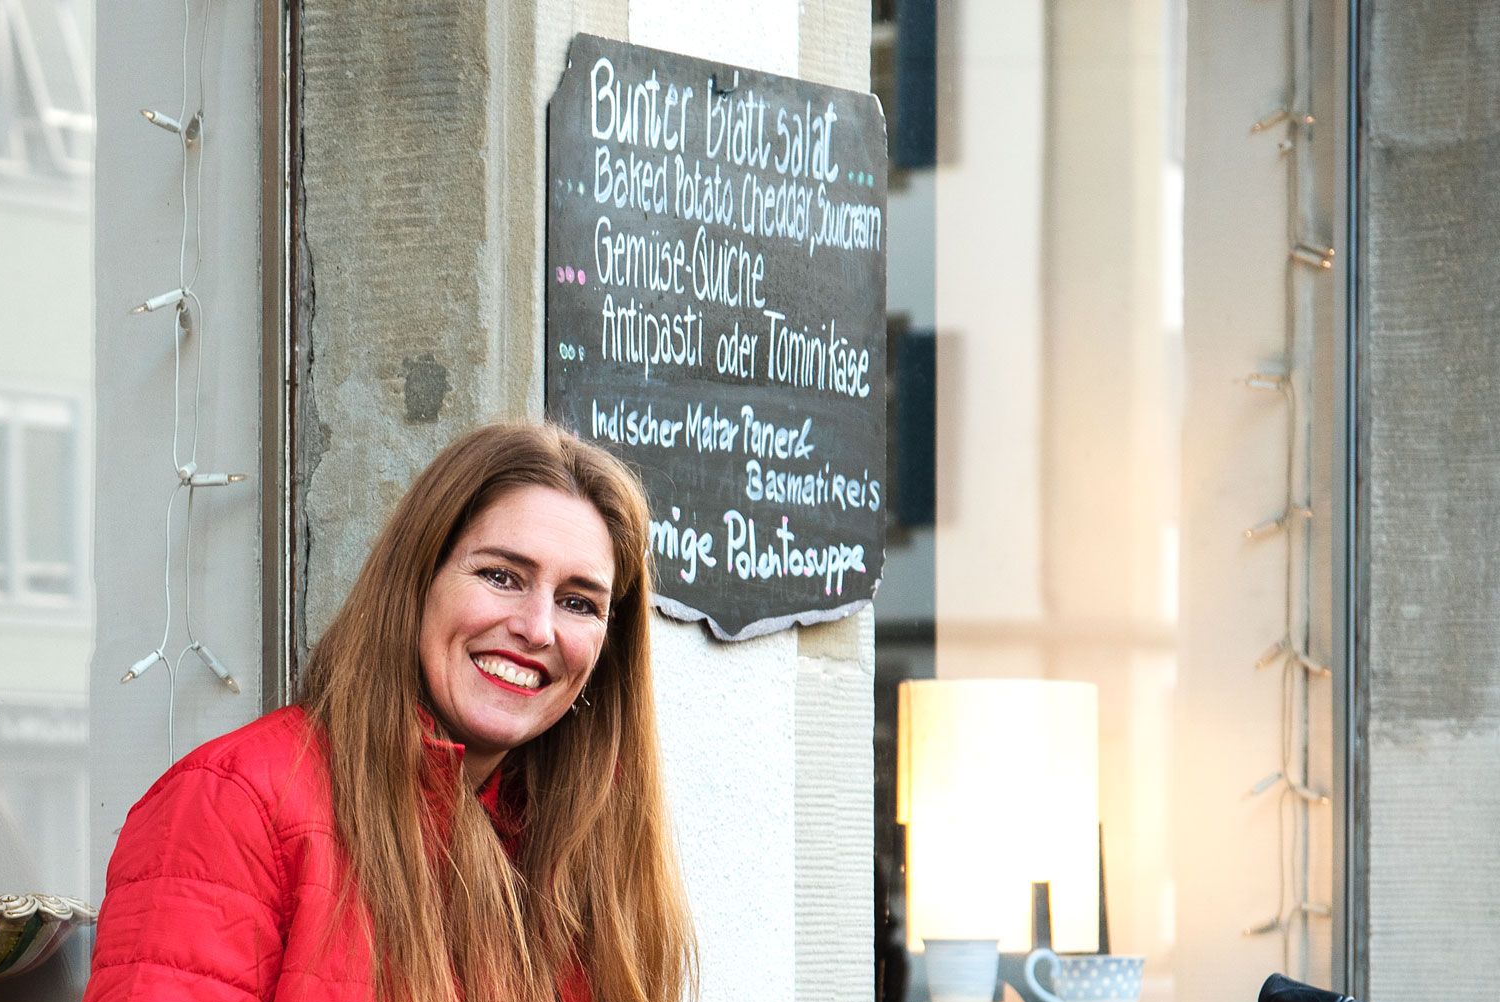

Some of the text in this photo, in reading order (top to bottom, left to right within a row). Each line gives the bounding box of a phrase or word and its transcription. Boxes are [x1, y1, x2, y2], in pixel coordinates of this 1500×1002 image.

[590, 57, 694, 154] Bunter
[594, 145, 668, 215] Baked
[602, 293, 703, 380] Antipasti
[716, 321, 759, 379] oder
[592, 399, 684, 446] Indischer
[686, 402, 740, 453] Matar
[645, 506, 717, 584] mige
